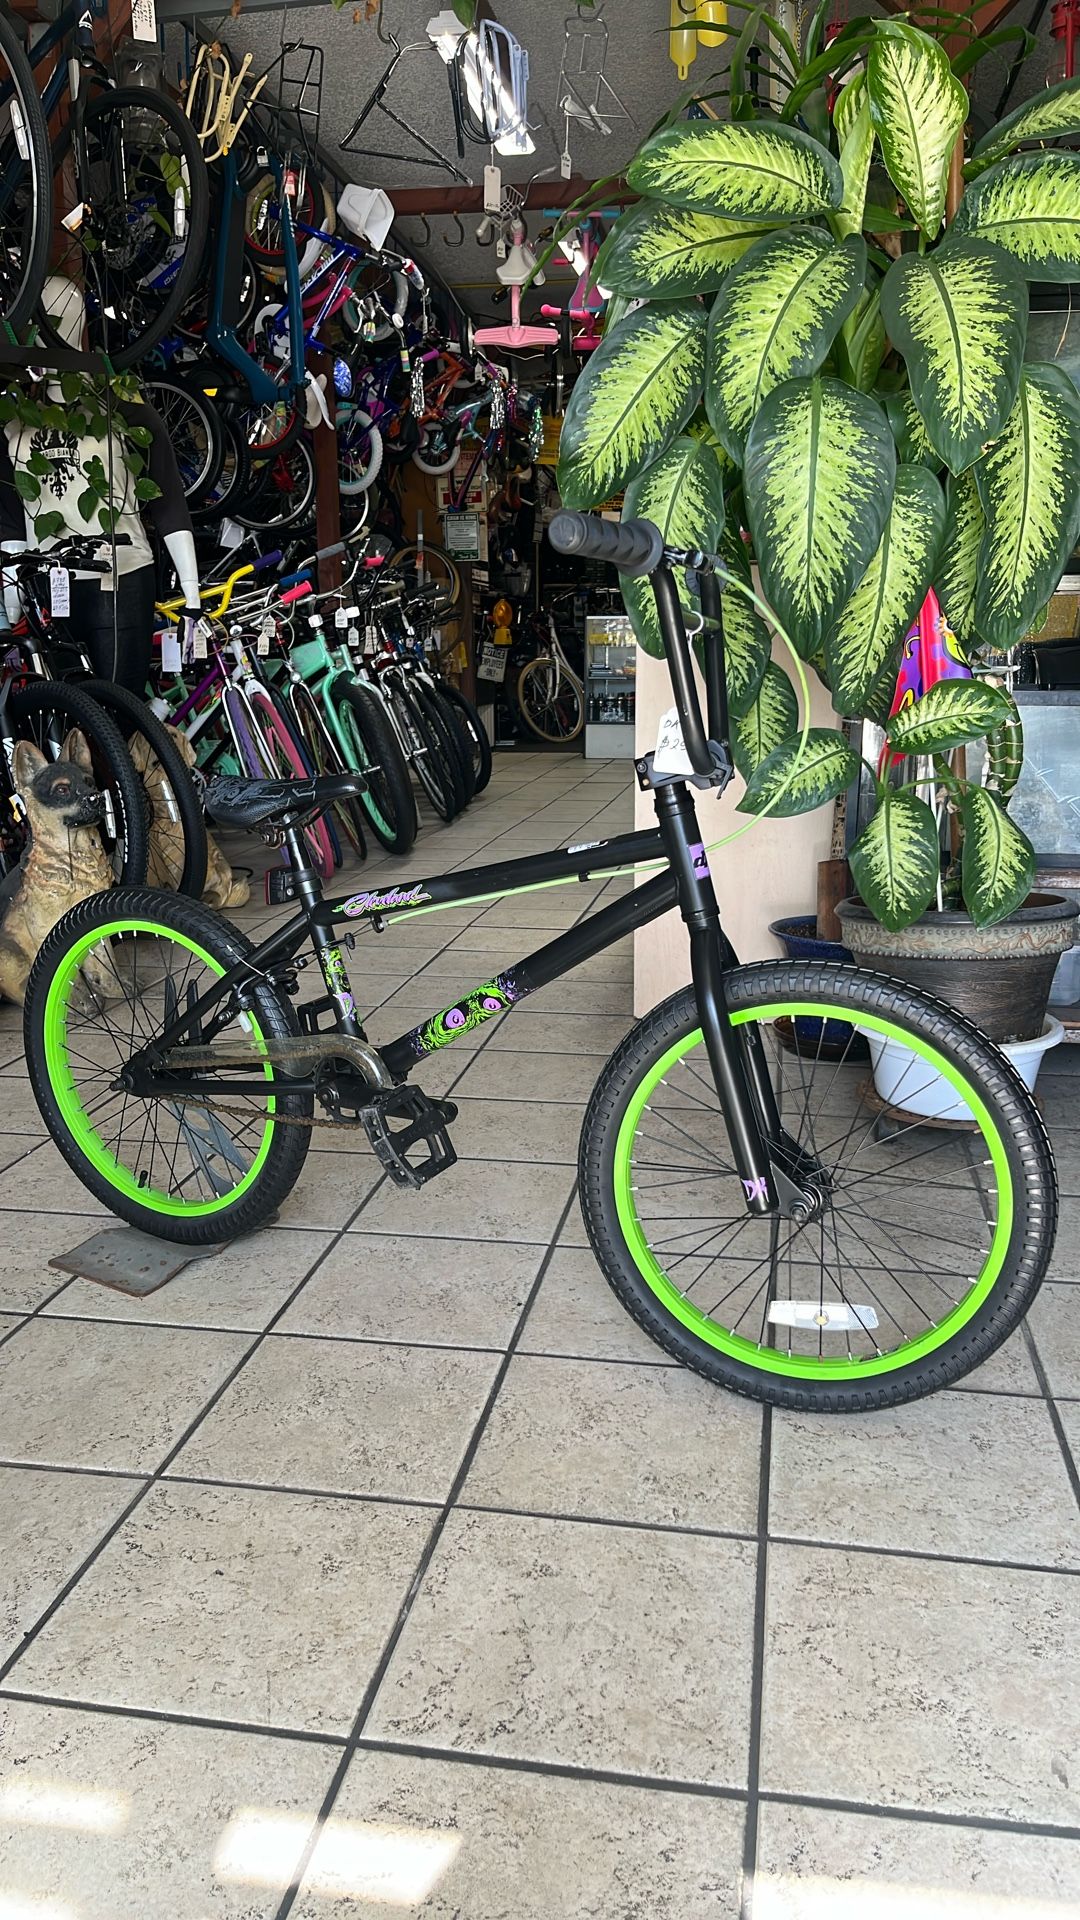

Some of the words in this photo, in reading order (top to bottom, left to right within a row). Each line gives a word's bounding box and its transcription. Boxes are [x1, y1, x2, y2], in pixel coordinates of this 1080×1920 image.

[483, 646, 505, 659] NOTICE
[481, 657, 504, 669] EMPLOYEES
[740, 1176, 770, 1204] DK
